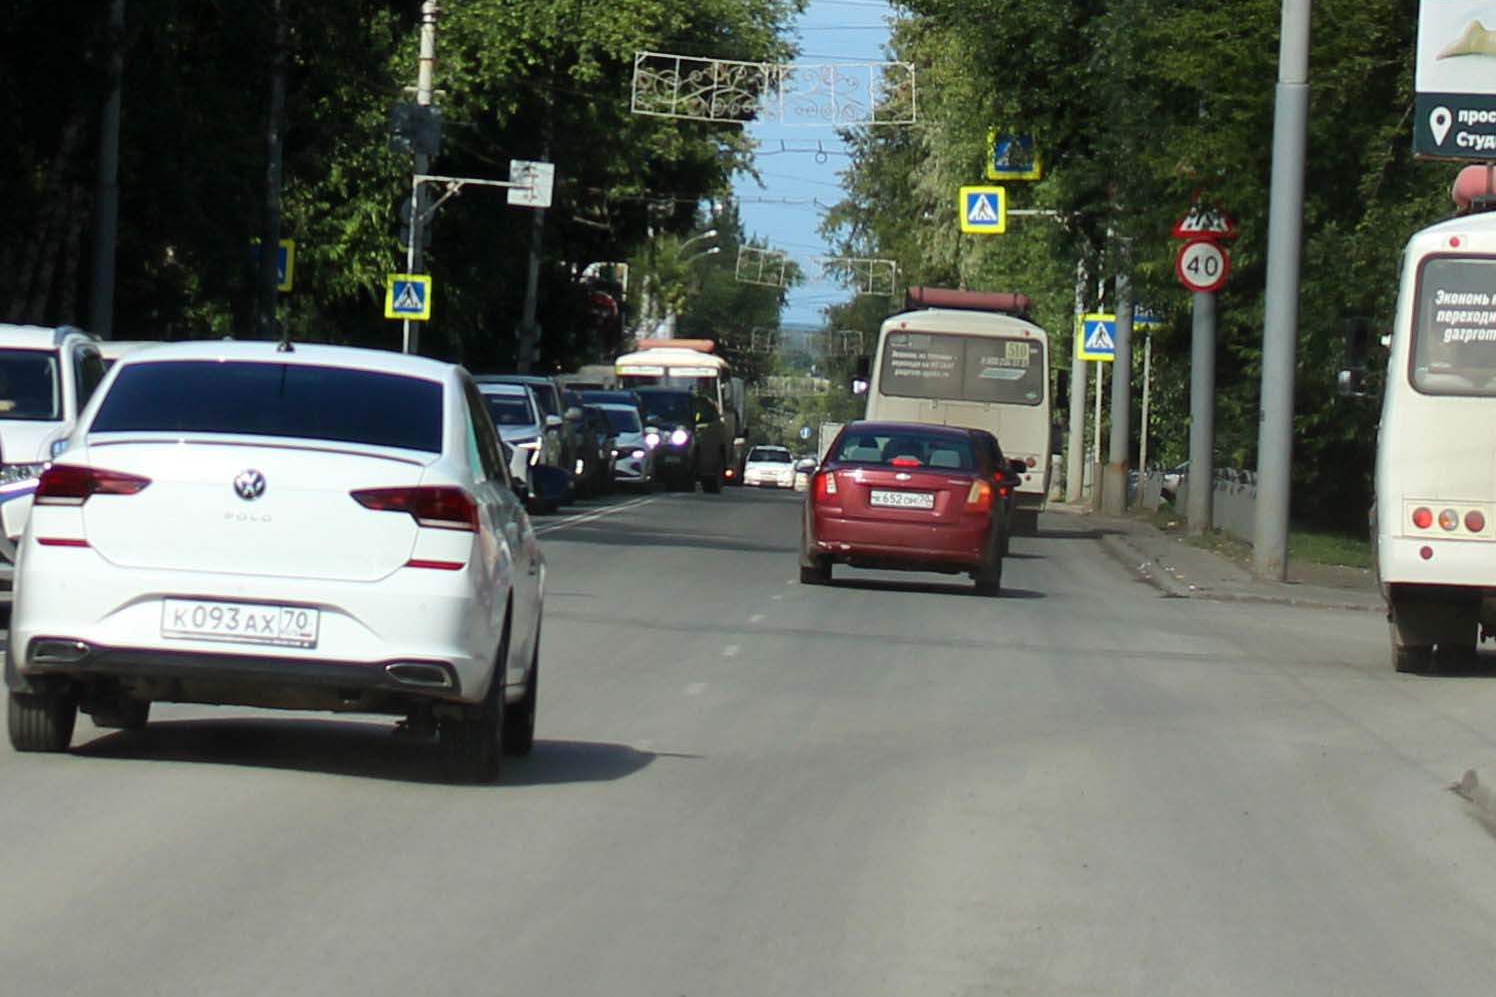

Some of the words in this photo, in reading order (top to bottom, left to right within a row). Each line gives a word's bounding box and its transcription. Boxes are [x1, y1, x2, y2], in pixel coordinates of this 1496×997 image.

[1187, 255, 1218, 277] 40
[1435, 290, 1490, 305] Экономь
[224, 512, 273, 522] POLO
